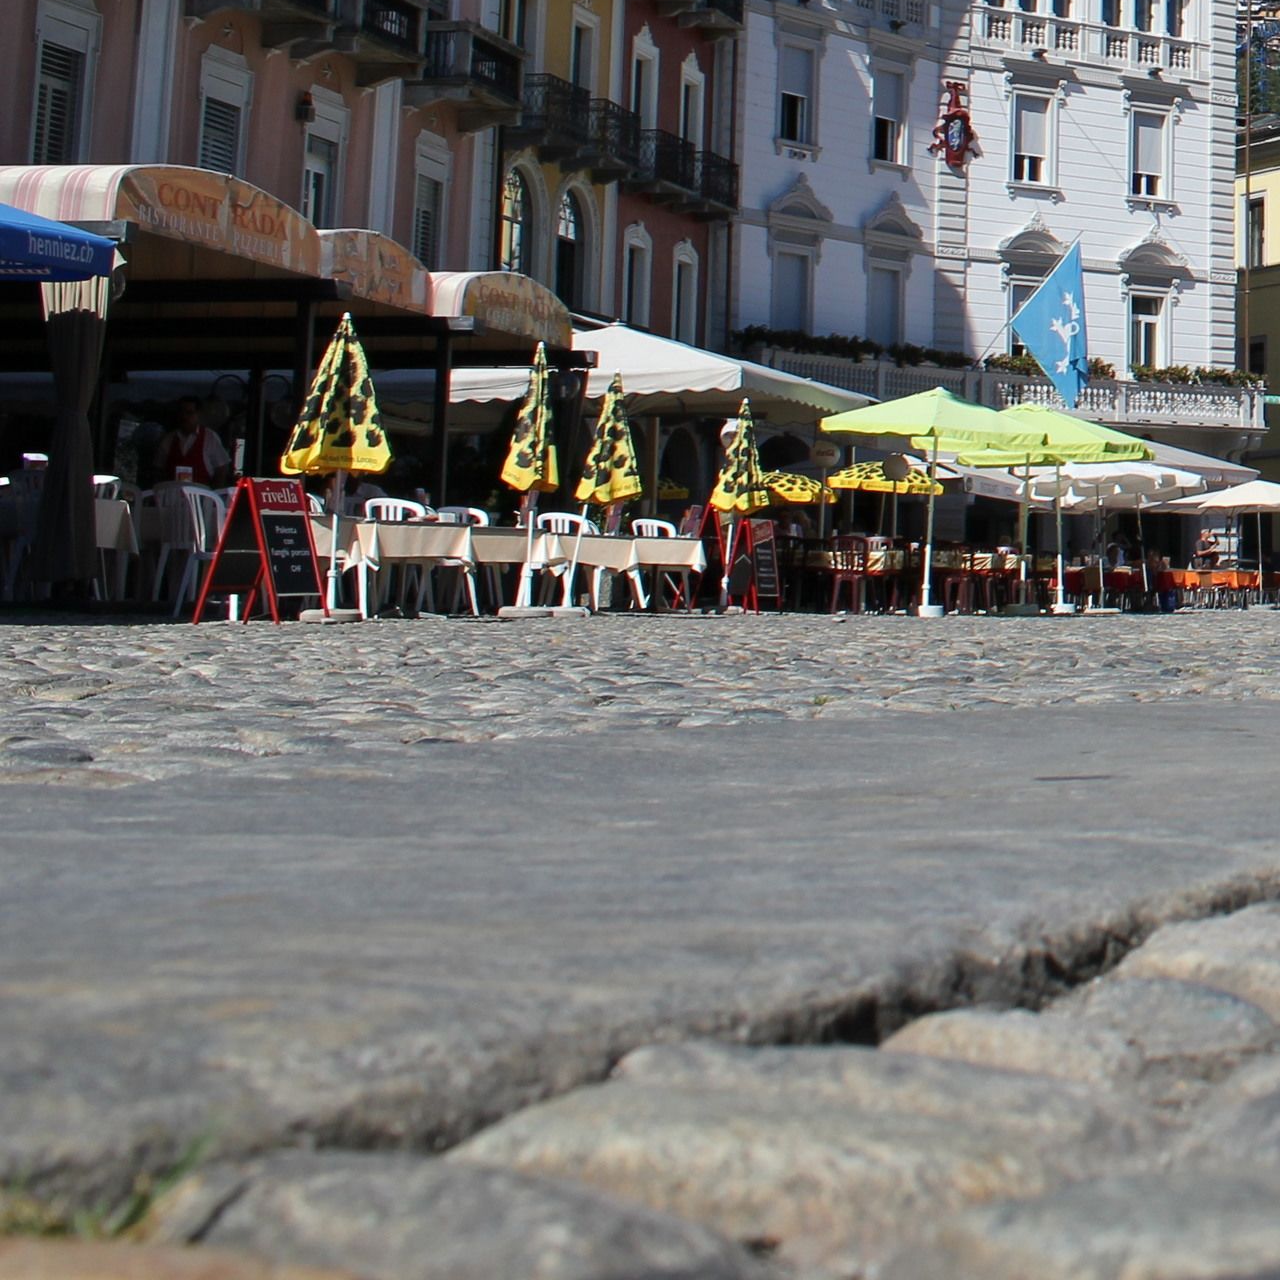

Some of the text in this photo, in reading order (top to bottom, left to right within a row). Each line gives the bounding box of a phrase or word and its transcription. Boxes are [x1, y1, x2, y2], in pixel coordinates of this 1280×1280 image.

[138, 204, 220, 242] RISTORANTE
[27, 229, 95, 263] henniez.ch
[261, 487, 298, 504] rivella
